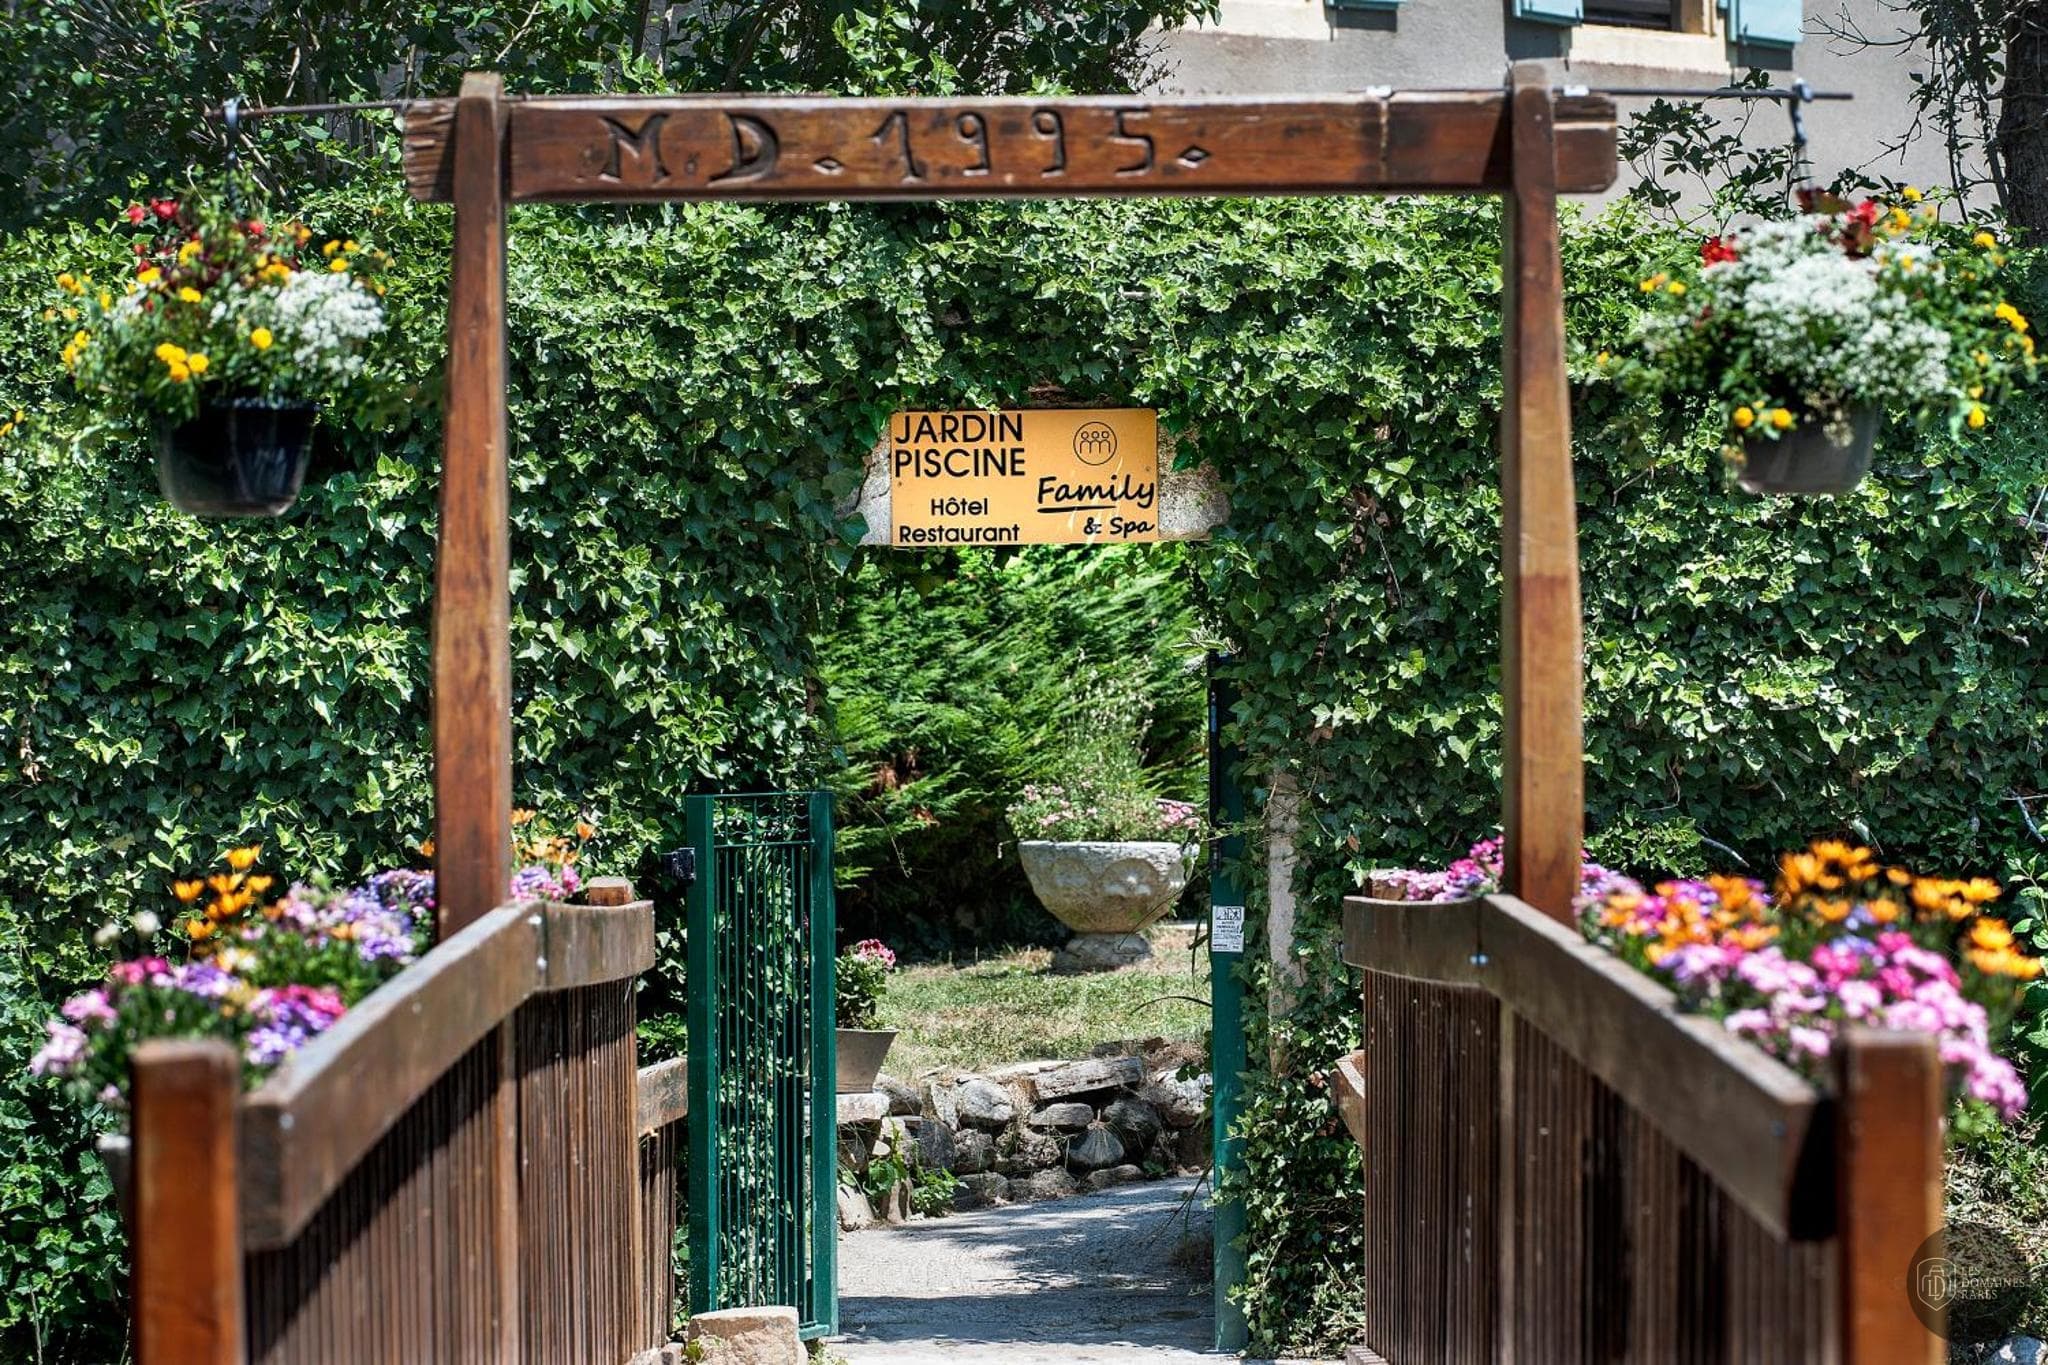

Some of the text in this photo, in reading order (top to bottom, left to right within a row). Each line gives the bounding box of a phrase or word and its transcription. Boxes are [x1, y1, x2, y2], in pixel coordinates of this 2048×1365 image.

[895, 413, 1023, 444] JARDIN
[895, 448, 1025, 478] PISCINE
[1037, 474, 1155, 508] Family
[931, 497, 988, 516] Hôtel
[900, 524, 1020, 543] Restaurant
[1083, 516, 1155, 538] & Spa
